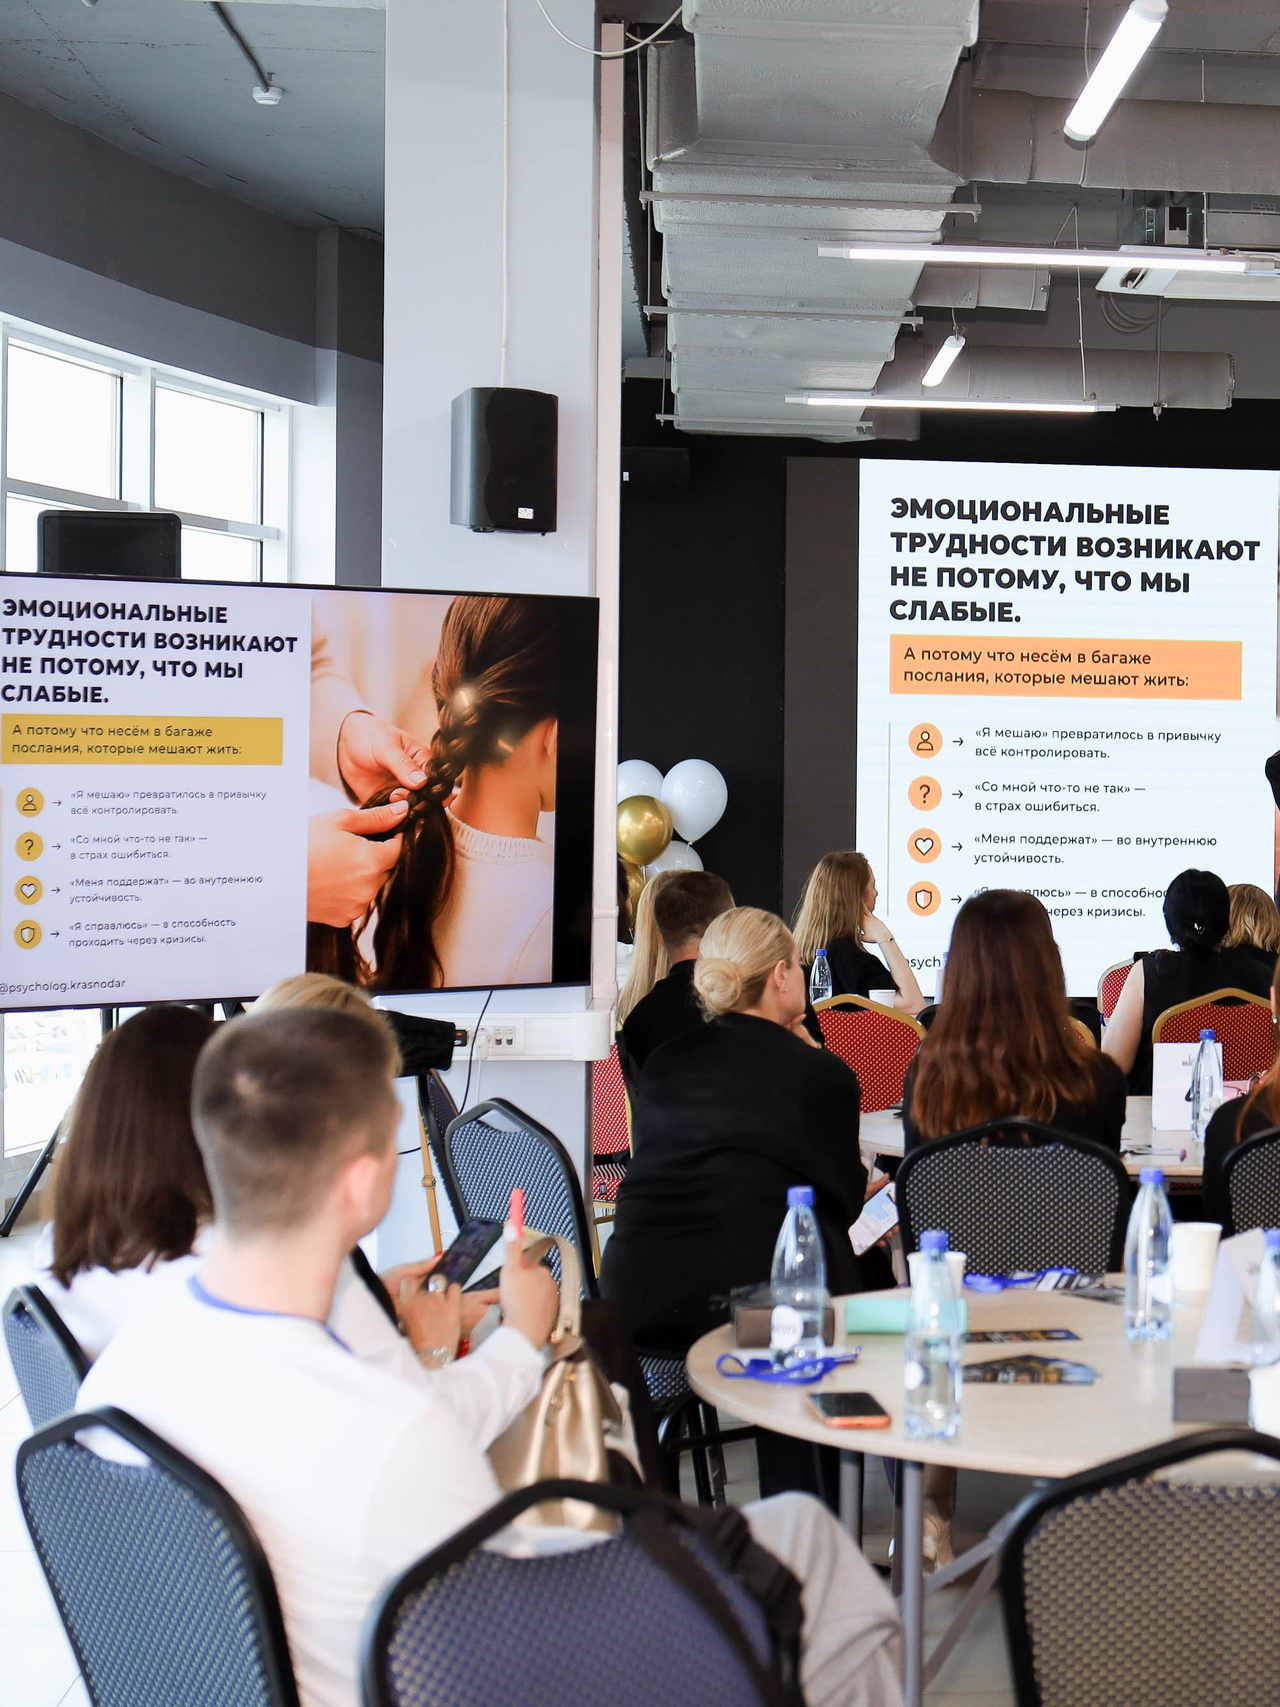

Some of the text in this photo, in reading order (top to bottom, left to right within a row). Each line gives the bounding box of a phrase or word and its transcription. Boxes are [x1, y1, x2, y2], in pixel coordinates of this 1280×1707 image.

[890, 497, 1170, 526] ЭМОЦИОНАЛЬНЫЕ
[889, 531, 1261, 562] ТРУДНОСТИ ВОЗНИКАЮТ
[890, 565, 1190, 595] НЕ ПОТОМУ, ЧТО МЫ
[2, 598, 228, 624] ЭМОЦИОНАЛЬНЫЕ
[889, 599, 1022, 623] СЛАБЫЕ.
[1, 627, 298, 653] ТРУДНОСТИ ВОЗНИКАЮТ
[903, 646, 1152, 665] А потому что несём в багаже
[1, 656, 243, 680] НЕ ПОТОМУ, ЧТО МЫ
[903, 670, 1189, 687] послания, которые мешают жить:
[0, 683, 109, 704] СЛАБЫЕ.
[11, 724, 213, 739] А потому что несём в багаже
[975, 726, 1222, 744] «Я мешаю» превратилось в привычку
[11, 744, 242, 757] послания, которые мешают жить:
[975, 745, 1110, 760] всё контролировать.
[974, 781, 999, 792] «Со
[1002, 781, 1037, 793] мной
[1039, 784, 1081, 793] что-то
[1084, 784, 1100, 794] не
[1102, 784, 1131, 794] так»
[70, 790, 267, 801] «Я мешаю» превратилось в привычку
[70, 805, 180, 817] всё контролировать.
[974, 800, 1100, 814] в страх ошибиться.
[70, 834, 90, 845] «Со
[92, 834, 121, 844] мной
[123, 835, 156, 844] что-то
[158, 835, 171, 844] не
[174, 835, 196, 843] так»
[974, 833, 1016, 844] «Меня
[1019, 835, 1098, 847] поддержат»
[1116, 836, 1132, 846] во
[1135, 836, 1218, 849] внутреннюю
[69, 849, 171, 862] в страх ошибиться.
[973, 852, 1065, 866] устойчивость.
[69, 878, 104, 887] «Меня
[106, 878, 169, 888] поддержат»
[184, 876, 196, 886] во
[198, 876, 263, 887] внутреннюю
[68, 892, 143, 906] устойчивость.
[1090, 888, 1098, 899] в
[1087, 907, 1146, 920] кризисы.
[68, 921, 82, 932] «Я
[84, 922, 148, 933] справлюсь»
[162, 921, 169, 930] в
[171, 917, 237, 929] способность
[68, 935, 208, 949] проходить через кризисы.
[0, 979, 126, 995] @psycholog.krasnodar
